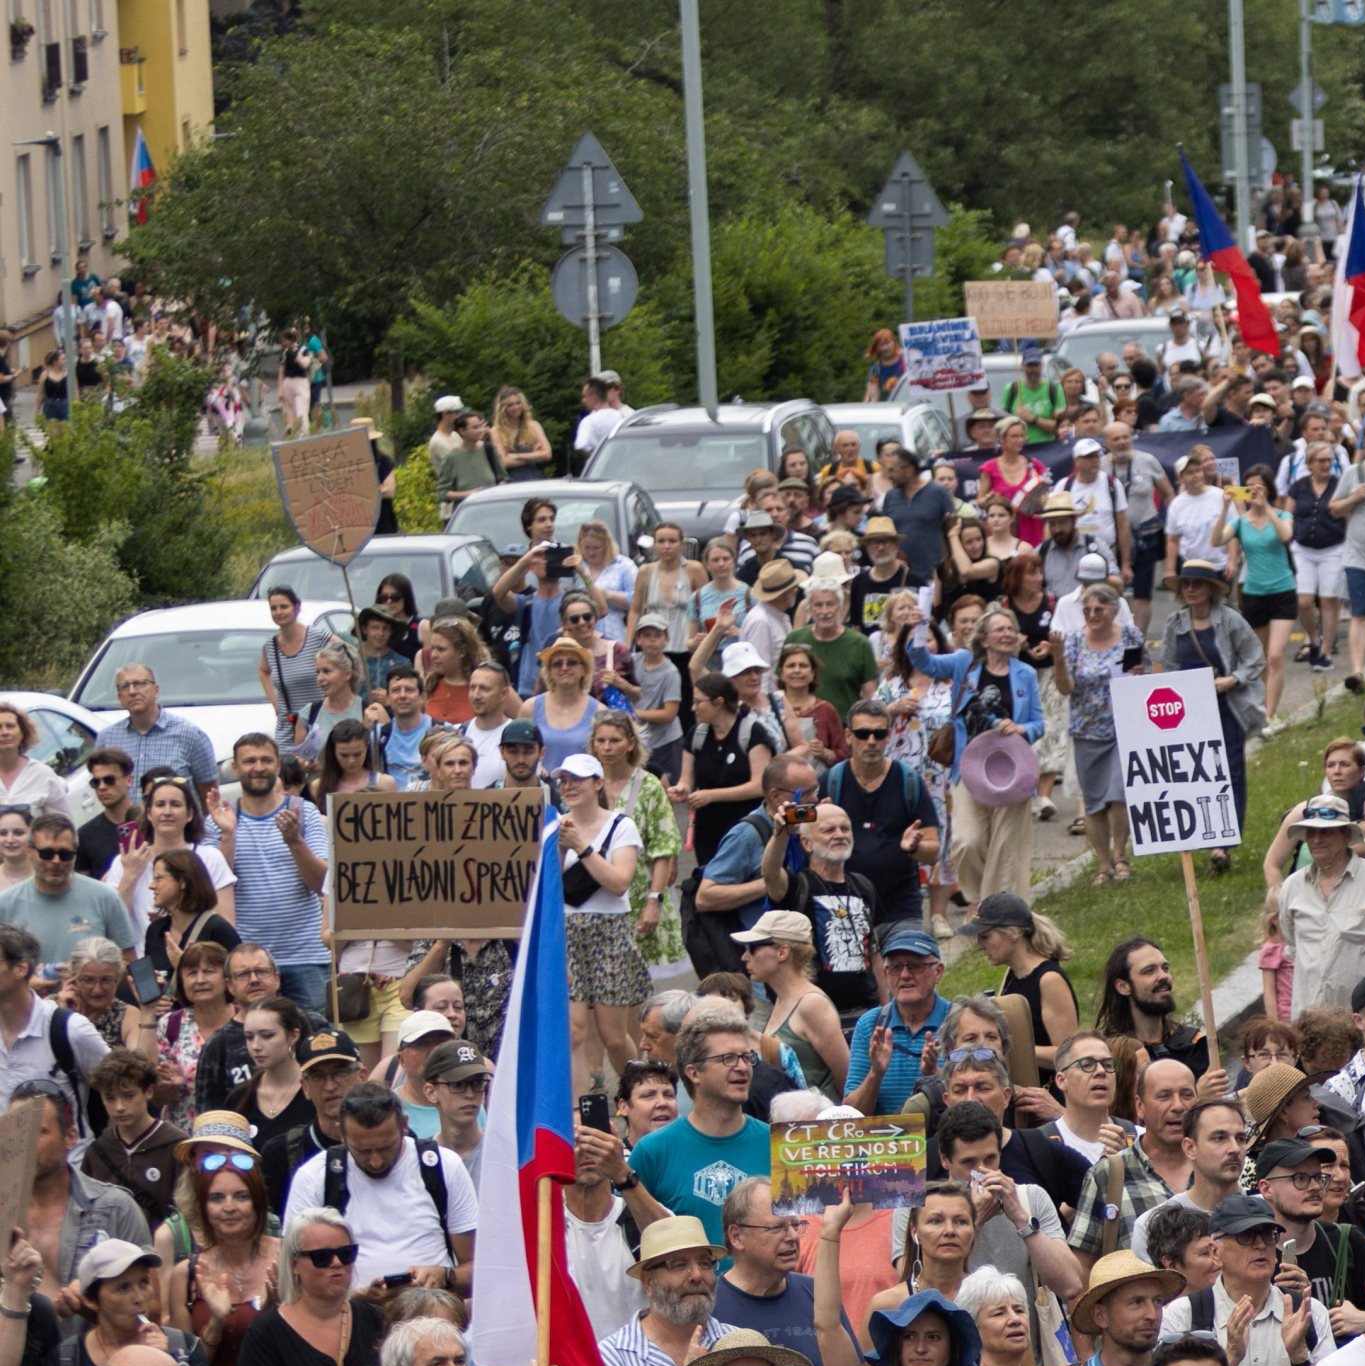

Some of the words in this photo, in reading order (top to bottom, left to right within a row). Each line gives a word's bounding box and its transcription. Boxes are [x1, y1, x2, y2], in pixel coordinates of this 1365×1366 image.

[289, 440, 347, 469] ČESKÁ
[1149, 701, 1183, 718] STOP
[1126, 739, 1228, 787] ANEXI
[336, 800, 419, 844] CHCEME
[424, 791, 459, 843] MÍT
[462, 792, 542, 843] ZPRÁVY
[1129, 784, 1237, 844] MÉDIÍ
[338, 860, 379, 904] BEZ
[384, 846, 466, 904] VLÁDNÍ
[461, 846, 538, 904] SPRÁV
[231, 1064, 253, 1085] 21
[784, 1122, 819, 1143] ČT
[827, 1120, 864, 1141] ČRo
[784, 1139, 920, 1162] VEŘEJNOSTI
[803, 1159, 898, 1179] POLITIKŮM
